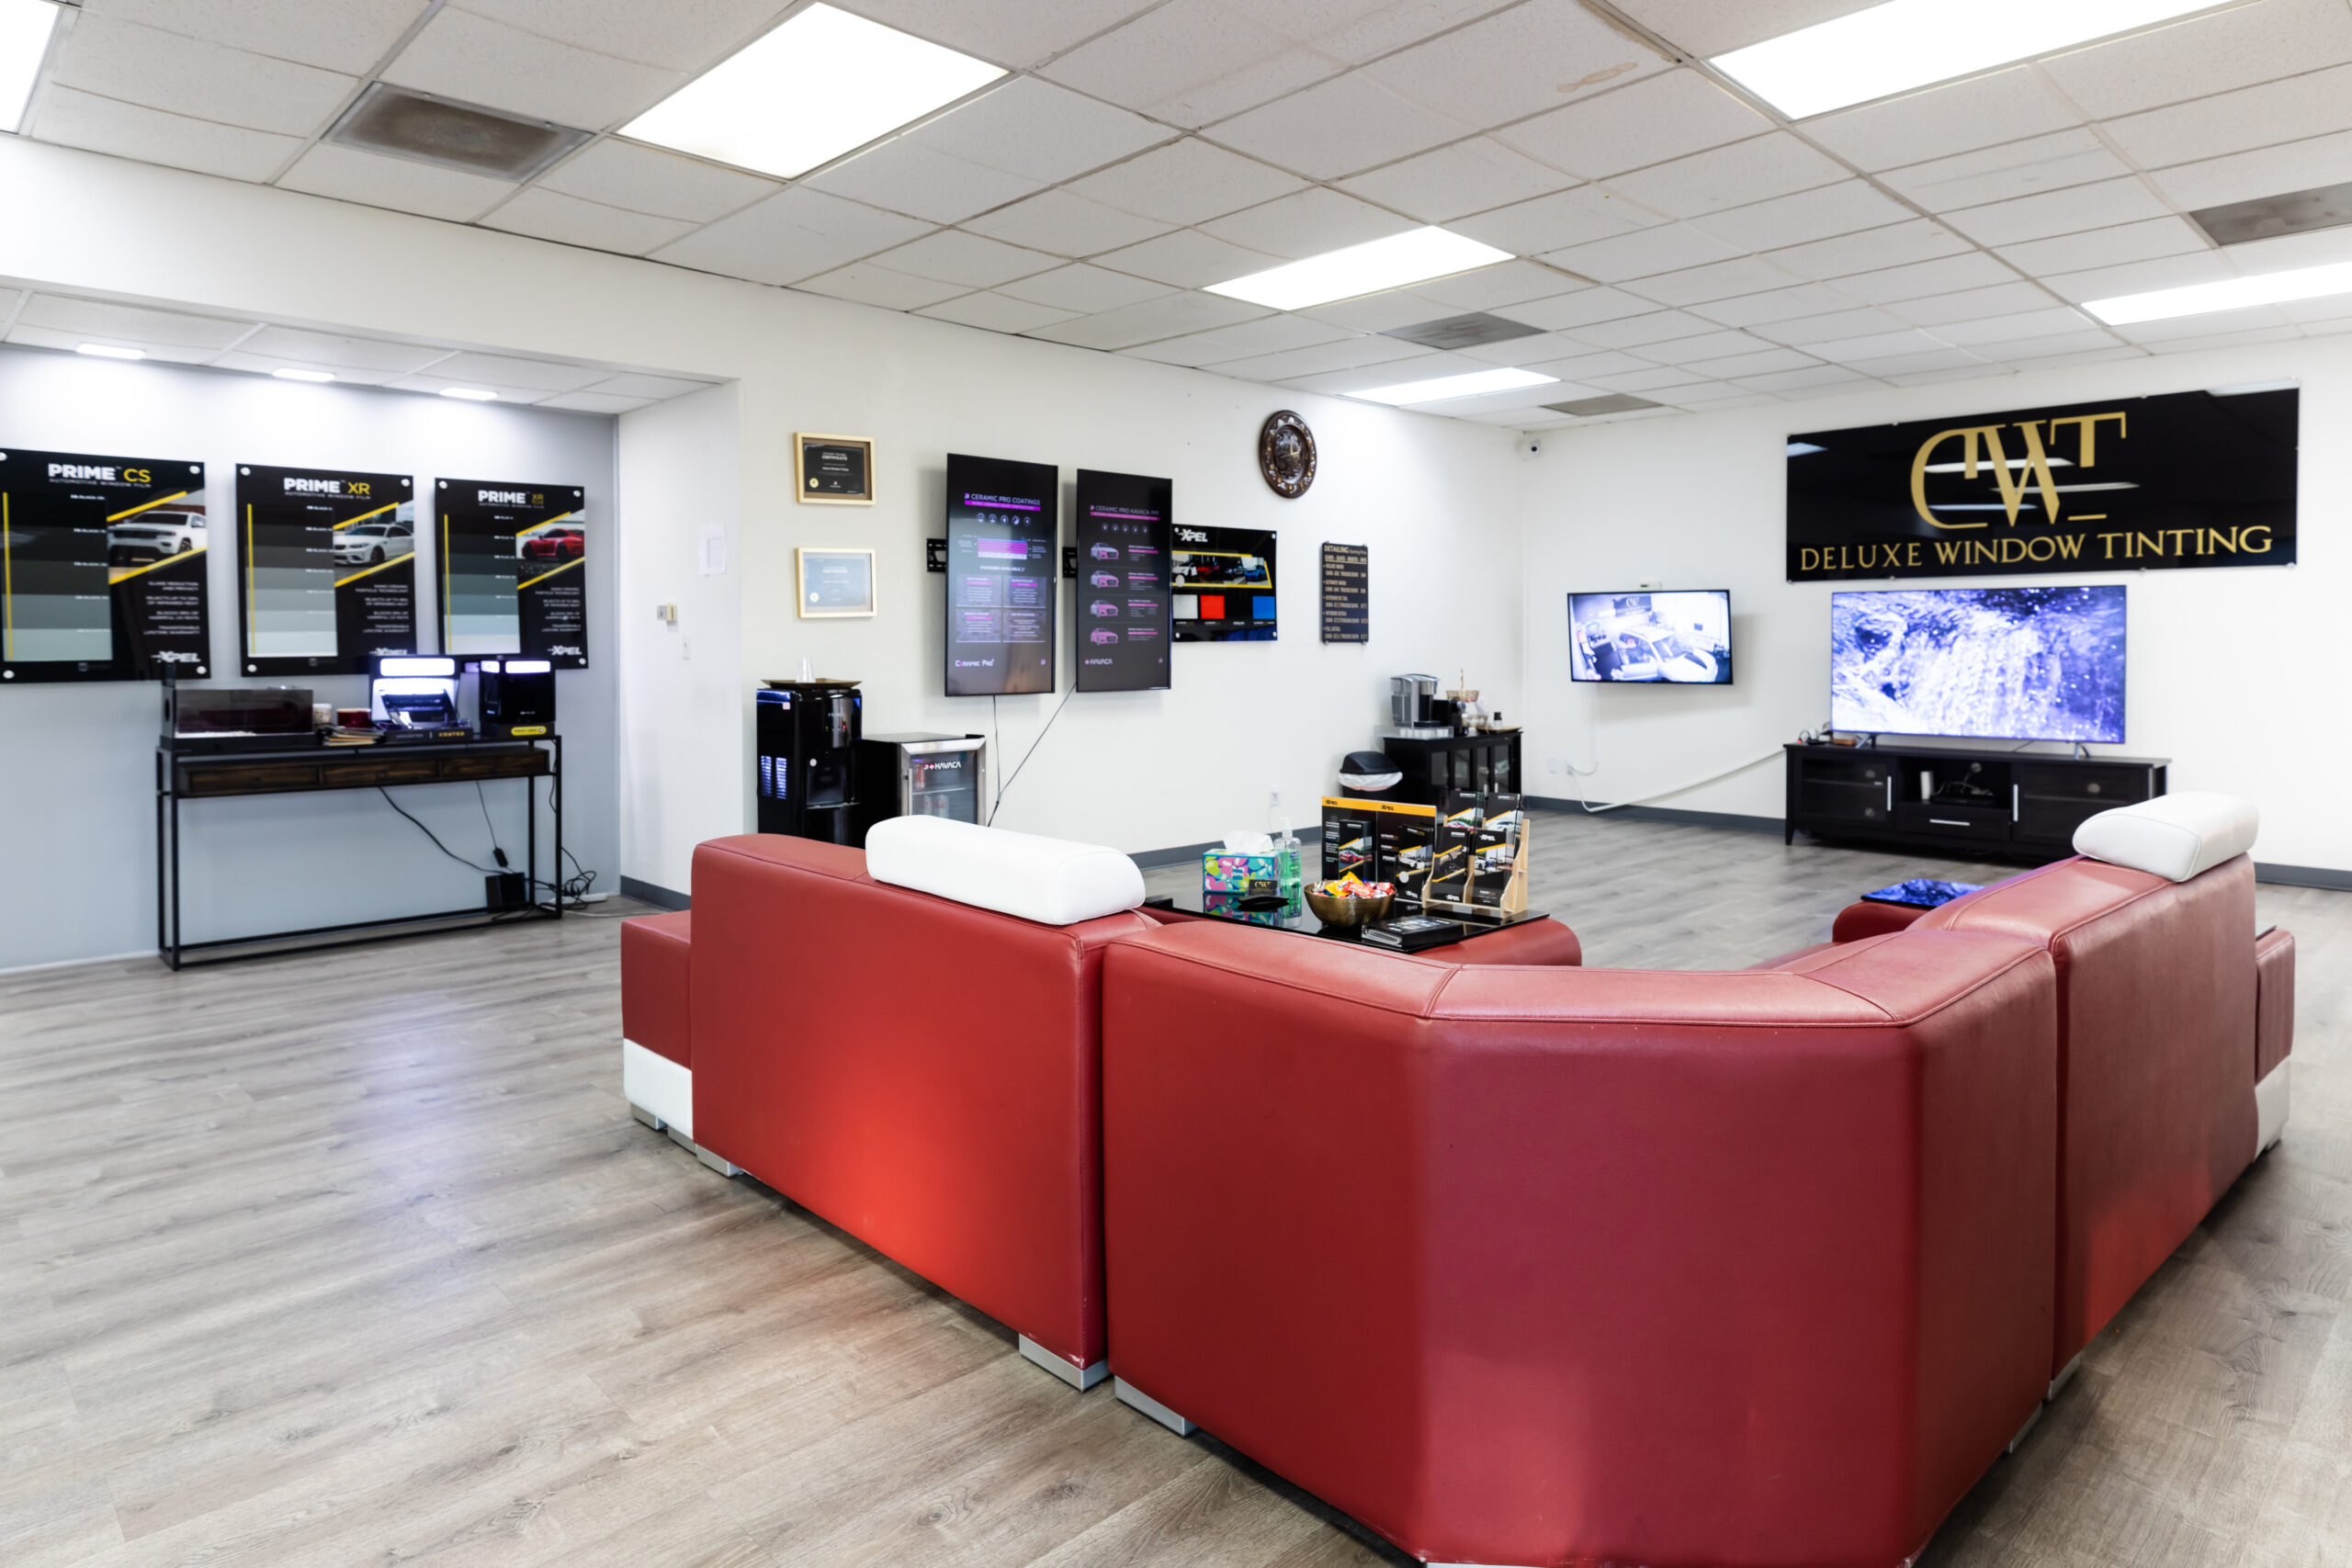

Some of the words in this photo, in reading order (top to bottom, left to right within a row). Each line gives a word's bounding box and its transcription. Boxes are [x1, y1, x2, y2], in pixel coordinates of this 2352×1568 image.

[48, 463, 117, 481] PRIME
[123, 468, 152, 483] CS
[283, 477, 341, 494] PRIME
[347, 481, 370, 495] XR
[478, 490, 526, 504] PRIME
[970, 493, 998, 502] CERAMIC
[1012, 498, 1041, 506] COATINGS
[1180, 528, 1209, 543] XPEL
[1324, 545, 1349, 554] DETAILING
[1801, 542, 1923, 571] DELUXE
[1933, 533, 2086, 566] WINDOW
[2097, 525, 2273, 559] TINTING
[157, 650, 201, 662] XPEL
[551, 645, 582, 656] XPEL
[934, 761, 961, 770] KAVACA
